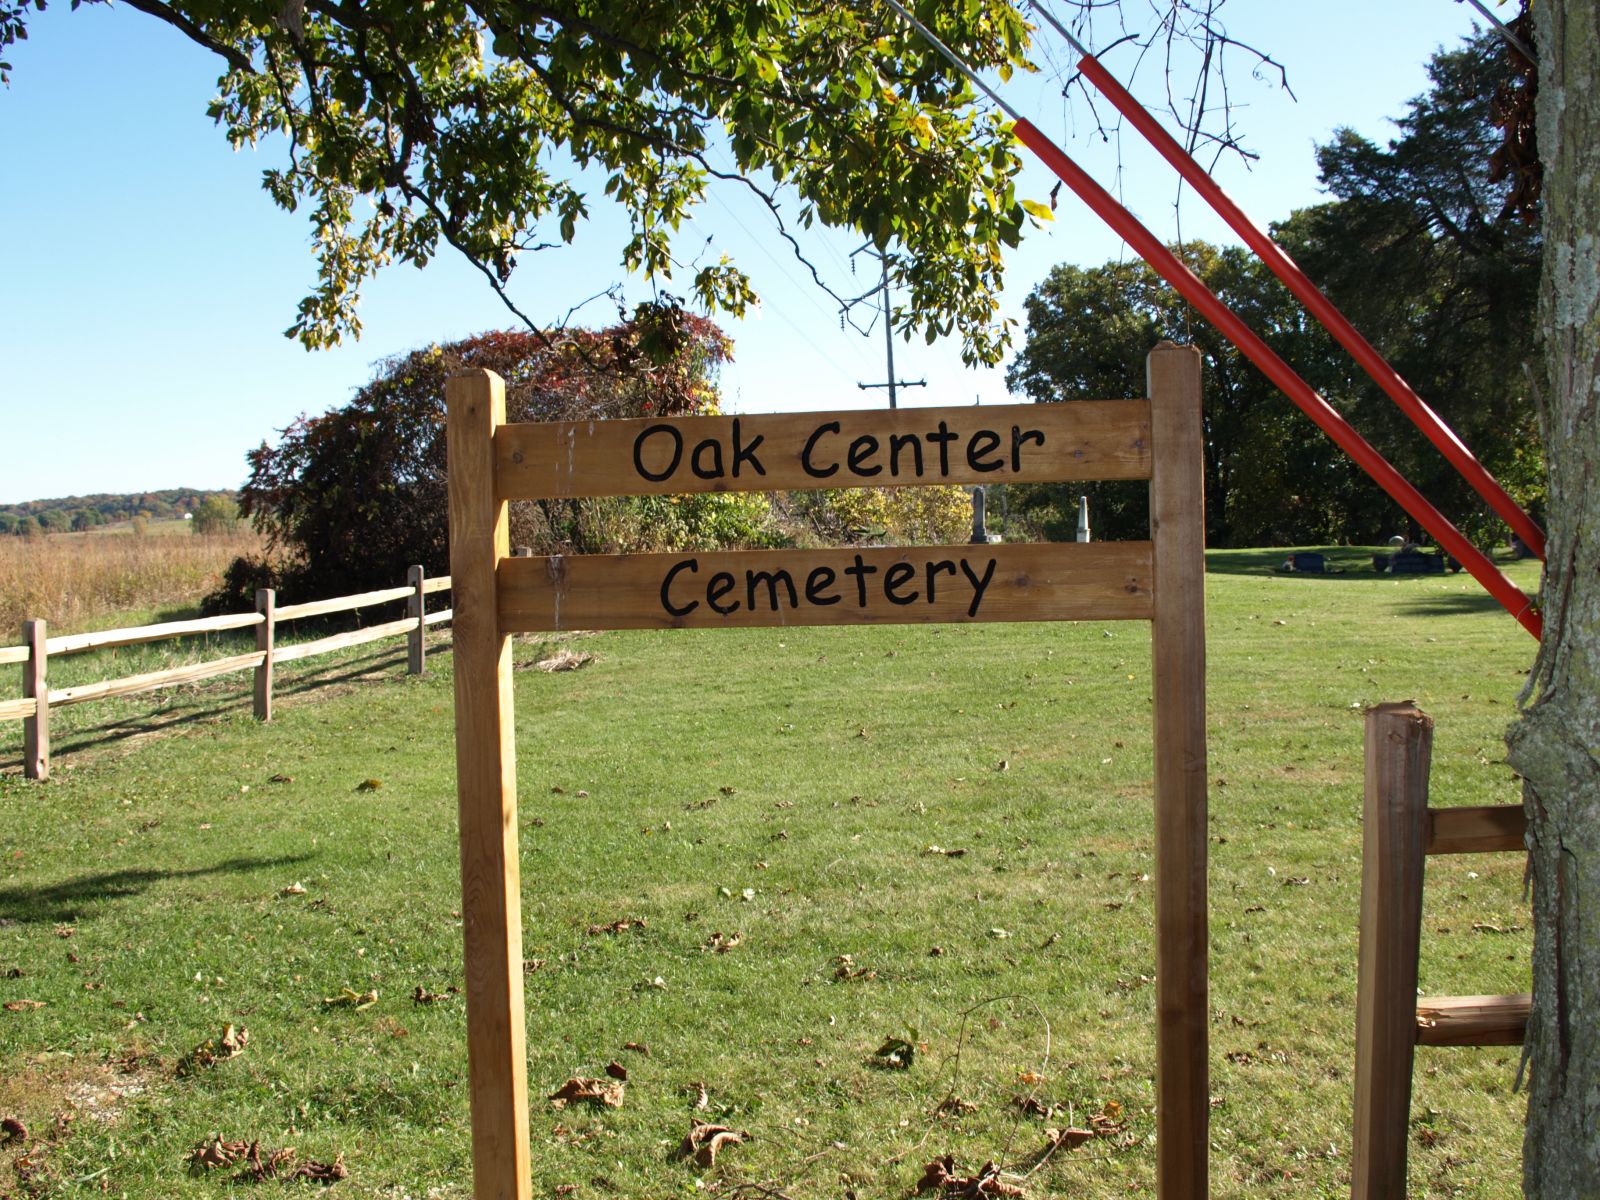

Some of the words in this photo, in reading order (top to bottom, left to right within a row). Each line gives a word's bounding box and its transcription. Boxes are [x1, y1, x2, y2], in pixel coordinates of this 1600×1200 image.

[633, 417, 767, 483] Oak
[799, 421, 1045, 477] Center
[659, 554, 997, 619] Cemetery
